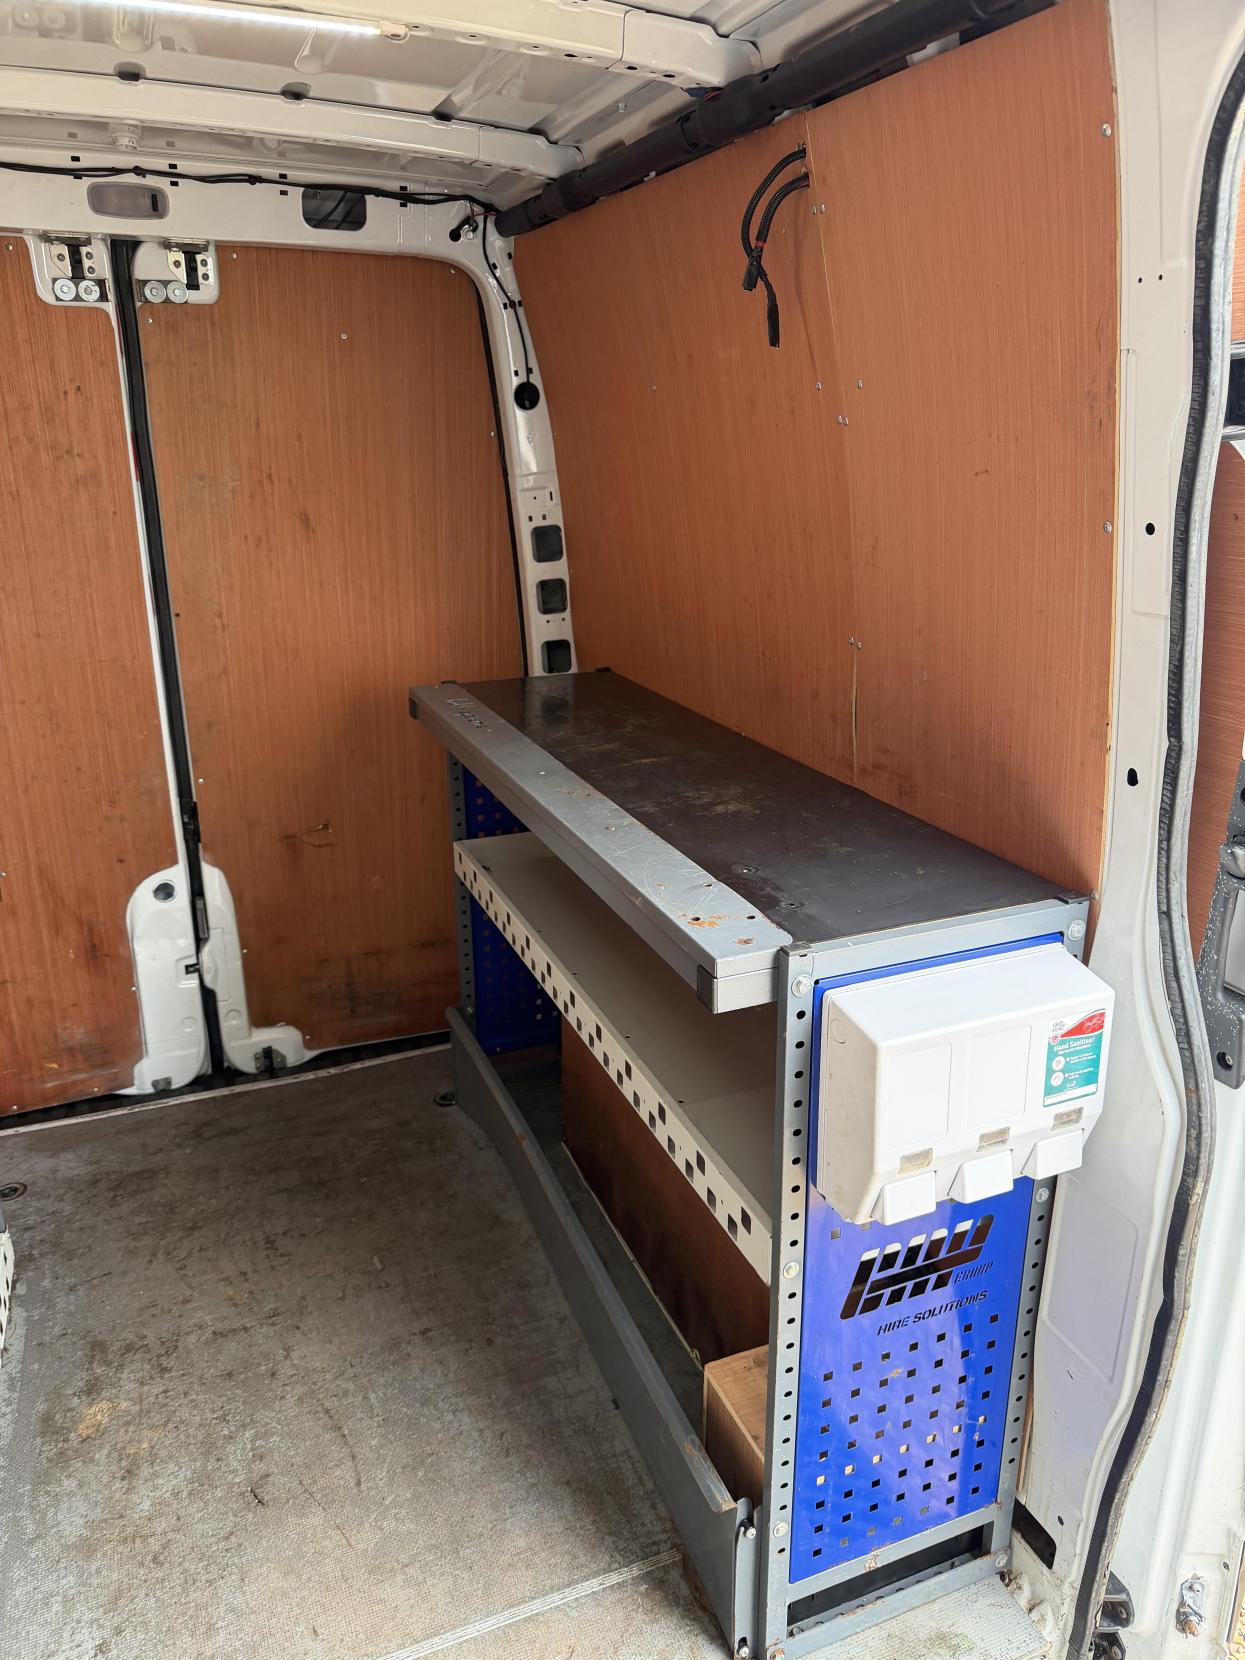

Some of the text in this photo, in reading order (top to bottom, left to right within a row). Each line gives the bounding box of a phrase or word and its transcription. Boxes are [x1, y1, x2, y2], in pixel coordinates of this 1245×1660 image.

[1054, 1041, 1069, 1052] Hand
[1069, 1037, 1095, 1047] Sanitiser
[876, 1290, 987, 1336] HIRE SOLUTIONS
